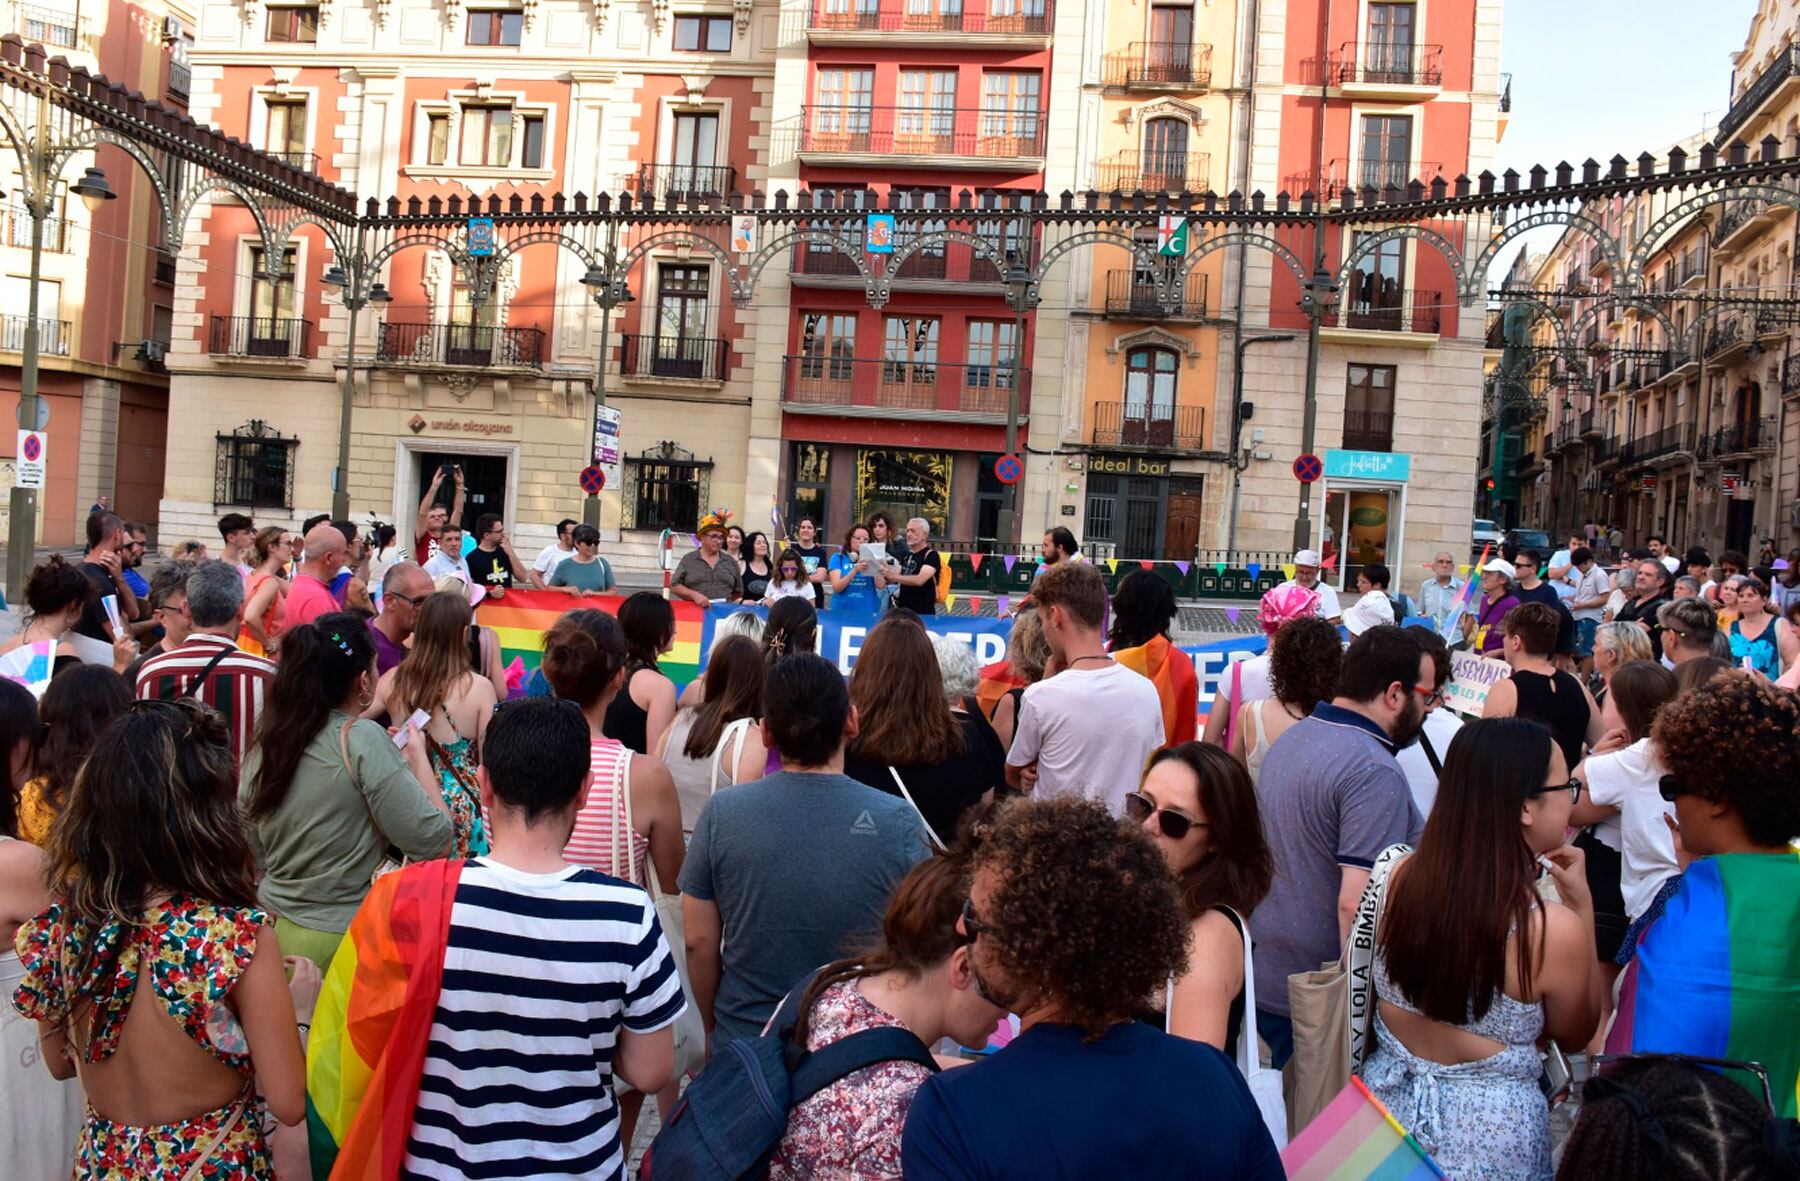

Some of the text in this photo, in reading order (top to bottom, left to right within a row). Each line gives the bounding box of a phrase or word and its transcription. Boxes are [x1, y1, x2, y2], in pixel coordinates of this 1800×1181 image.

[431, 418, 513, 435] unión alcoyana
[1089, 456, 1167, 474] ideal bar
[1352, 965, 1369, 1018] LOLA
[1352, 1028, 1363, 1042] Y
